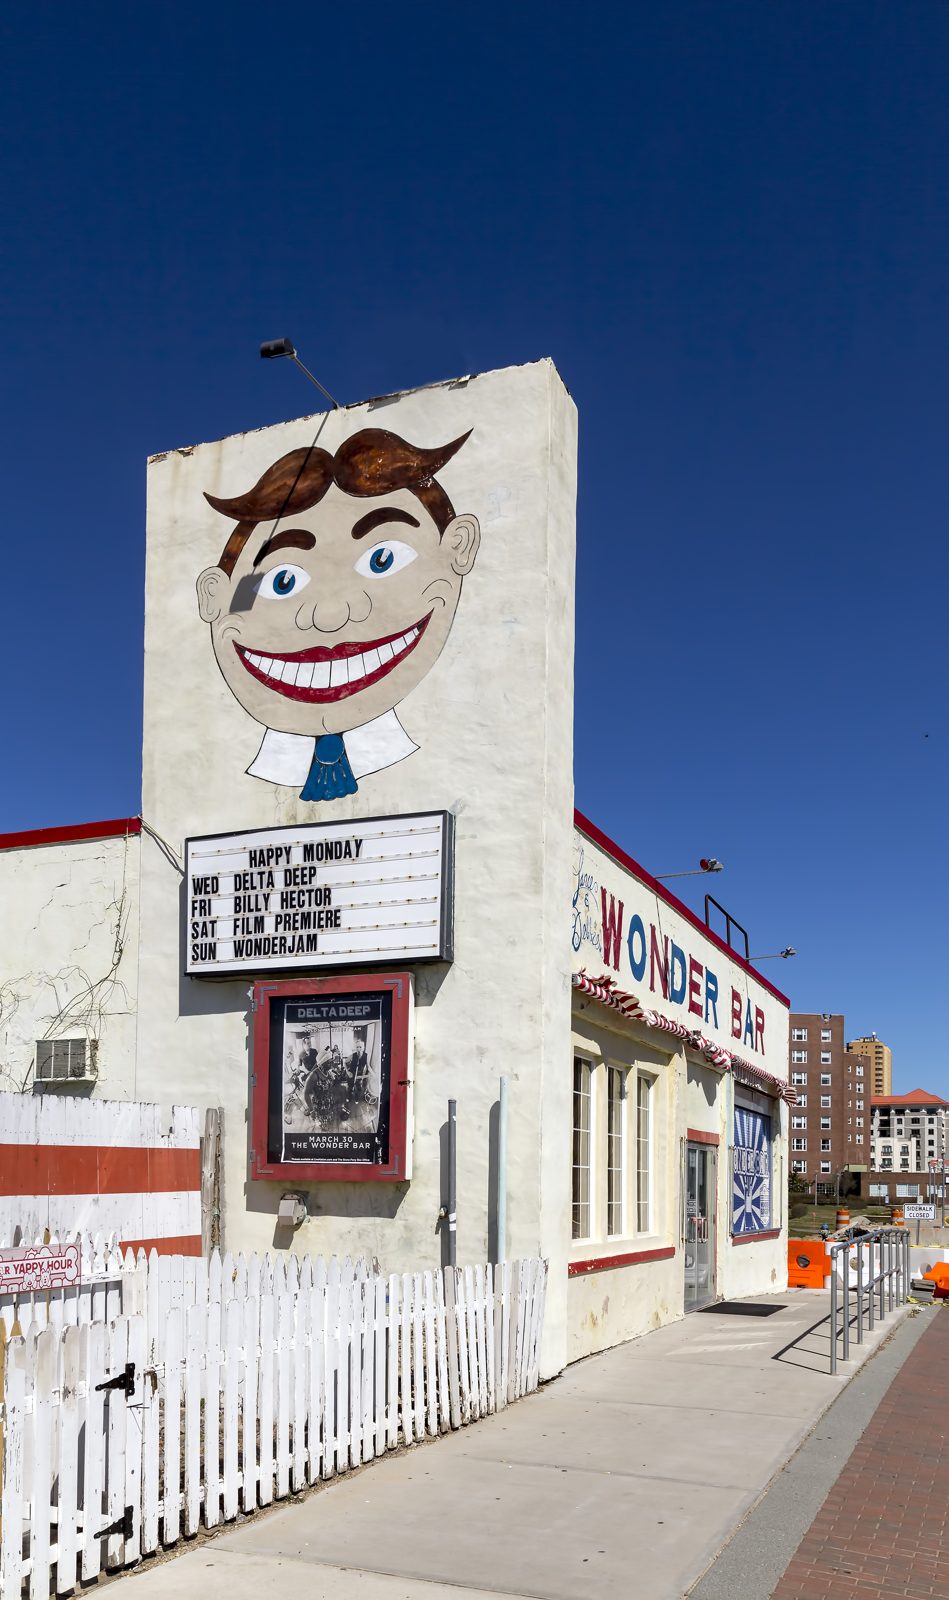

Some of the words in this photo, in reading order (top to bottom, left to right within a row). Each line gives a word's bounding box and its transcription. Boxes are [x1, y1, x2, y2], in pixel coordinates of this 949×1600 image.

[249, 846, 292, 868] HAPPY
[303, 839, 363, 862] MONDAY
[192, 876, 219, 896] WED
[234, 870, 275, 892] DELTA
[284, 866, 317, 887] DEEP
[191, 898, 212, 917] FRI
[234, 893, 271, 914] BILLY
[280, 888, 332, 910] HECTOR
[191, 920, 217, 939] SAT
[233, 915, 265, 936] FILM
[275, 909, 341, 932] PREMIERE
[191, 942, 217, 962] SUN
[233, 933, 318, 958] WONDERJAM
[600, 886, 719, 1030] WONDER
[730, 985, 766, 1056] BAR
[297, 1007, 338, 1018] DELTA
[339, 1005, 371, 1016] DEEP
[13, 1262, 44, 1275] YAPPY
[47, 1258, 73, 1271] HOUR
